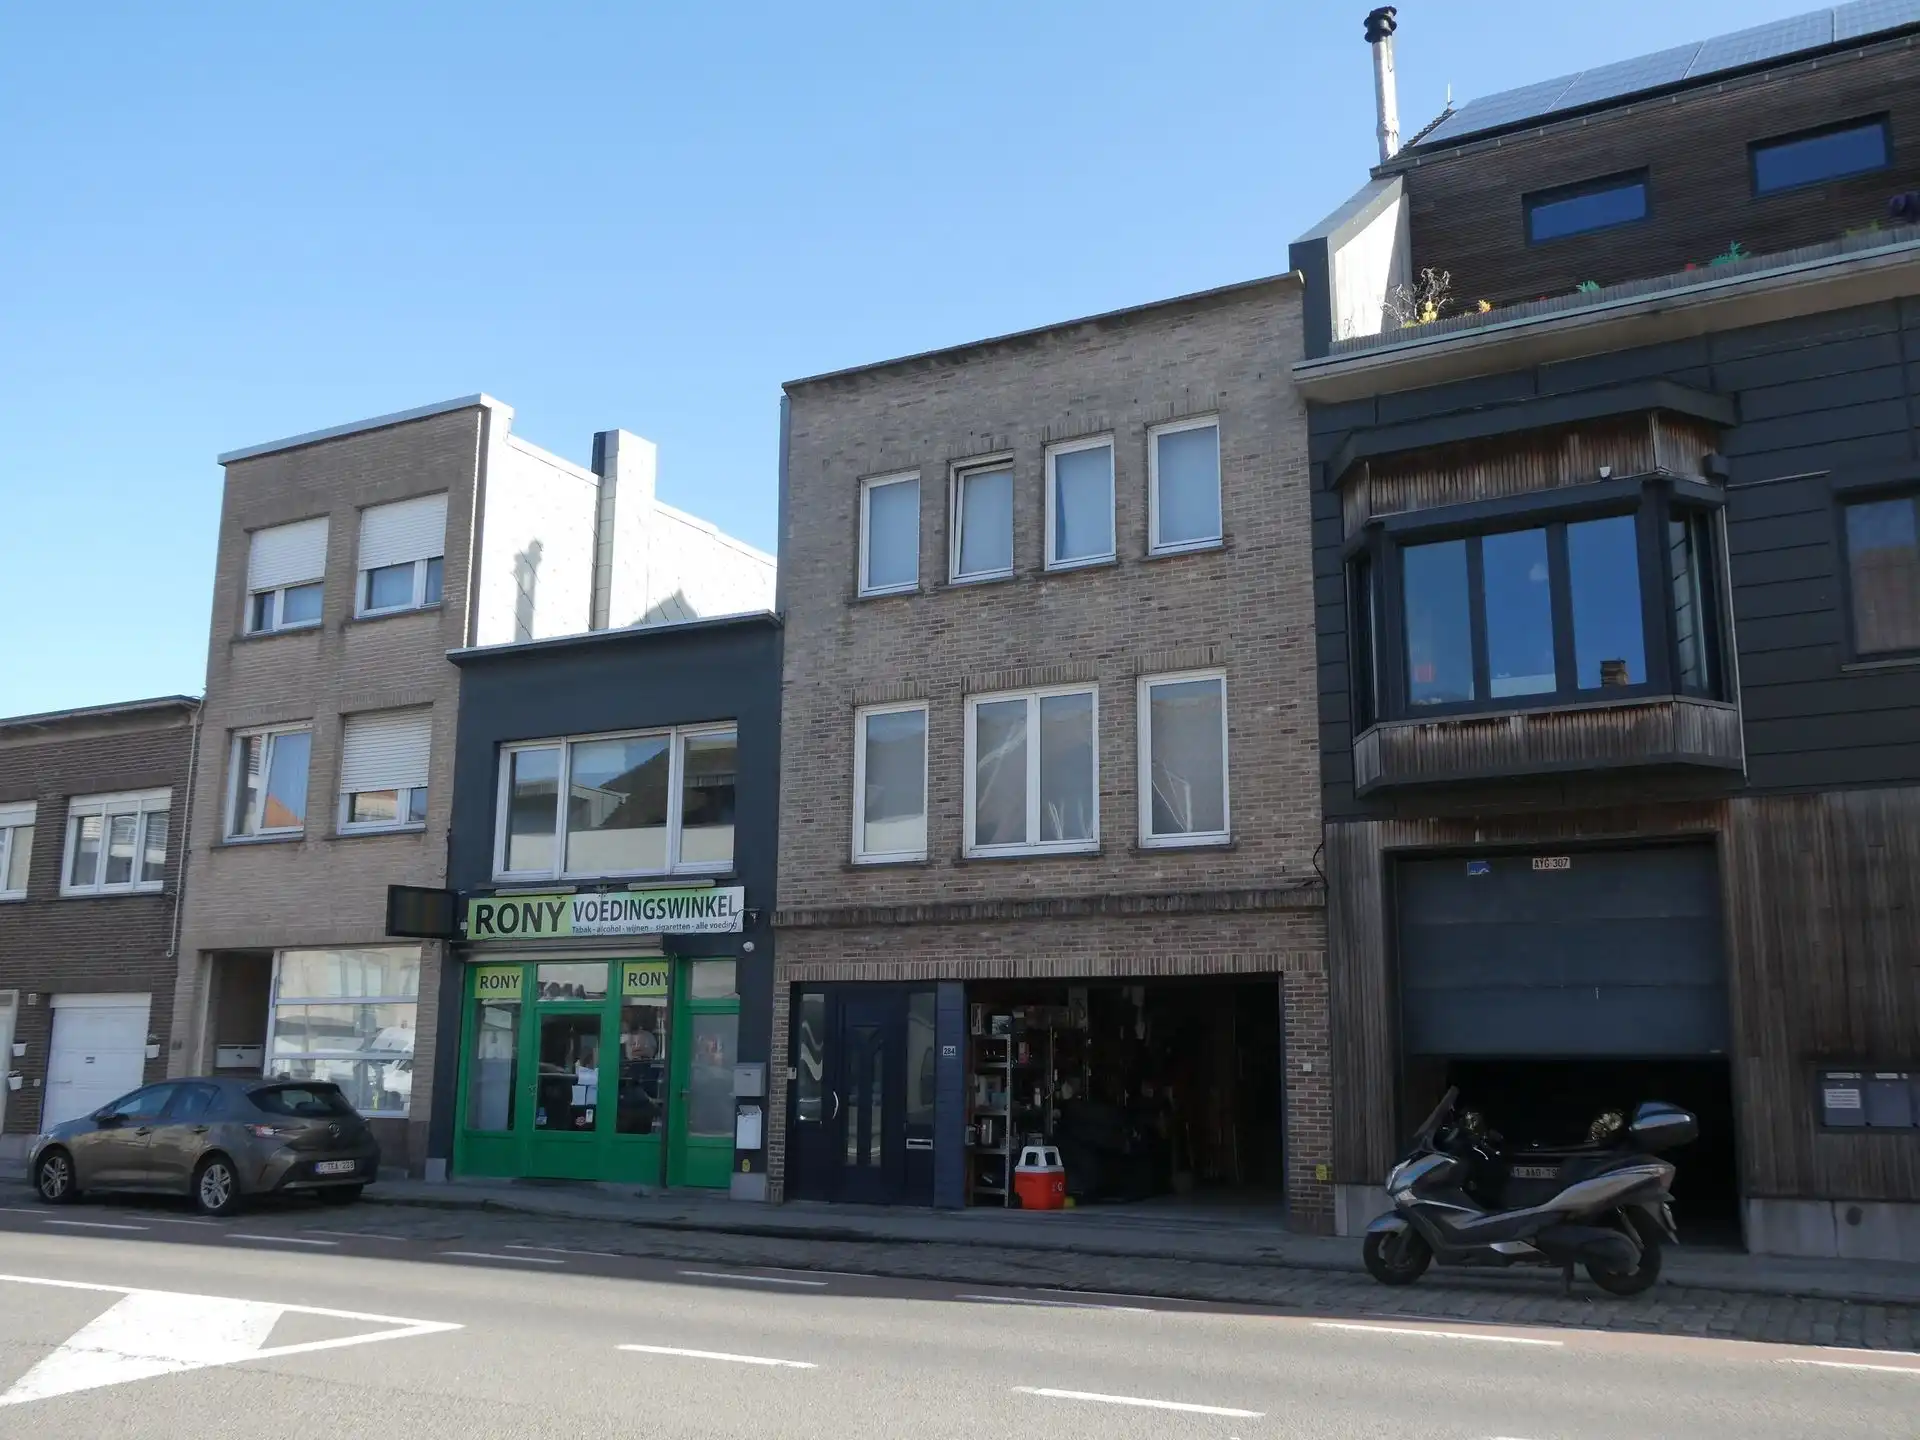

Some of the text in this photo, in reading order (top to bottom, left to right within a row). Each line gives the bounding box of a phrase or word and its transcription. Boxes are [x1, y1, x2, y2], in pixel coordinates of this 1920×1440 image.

[572, 894, 738, 923] VOEDINGSWINKEL
[475, 901, 567, 935] RONY
[572, 920, 738, 934] Tabak alcohol wijnen sigaretten alle voeding
[480, 974, 521, 989] RONY
[943, 1047, 955, 1055] 284
